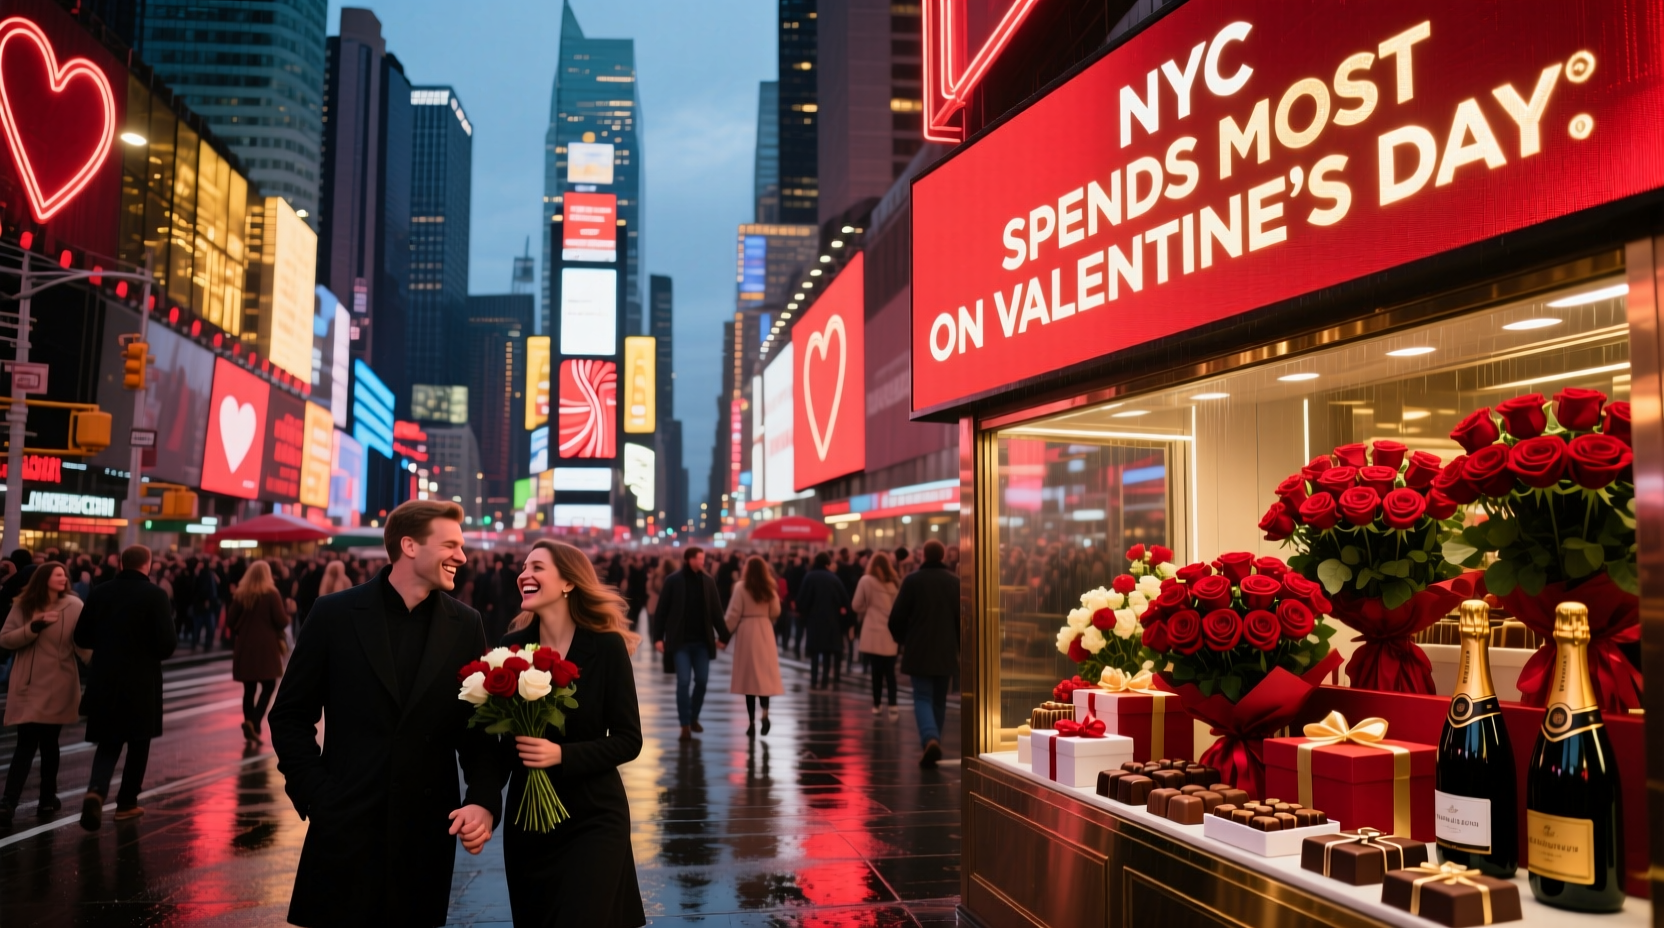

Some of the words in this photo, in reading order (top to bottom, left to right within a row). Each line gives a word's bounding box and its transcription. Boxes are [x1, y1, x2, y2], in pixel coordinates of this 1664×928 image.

[1001, 136, 1200, 271] SPENDS
[1218, 20, 1431, 180] MOST
[1119, 20, 1254, 149] NYC
[929, 298, 984, 362] ON
[993, 154, 1352, 339] VALENTINE'S
